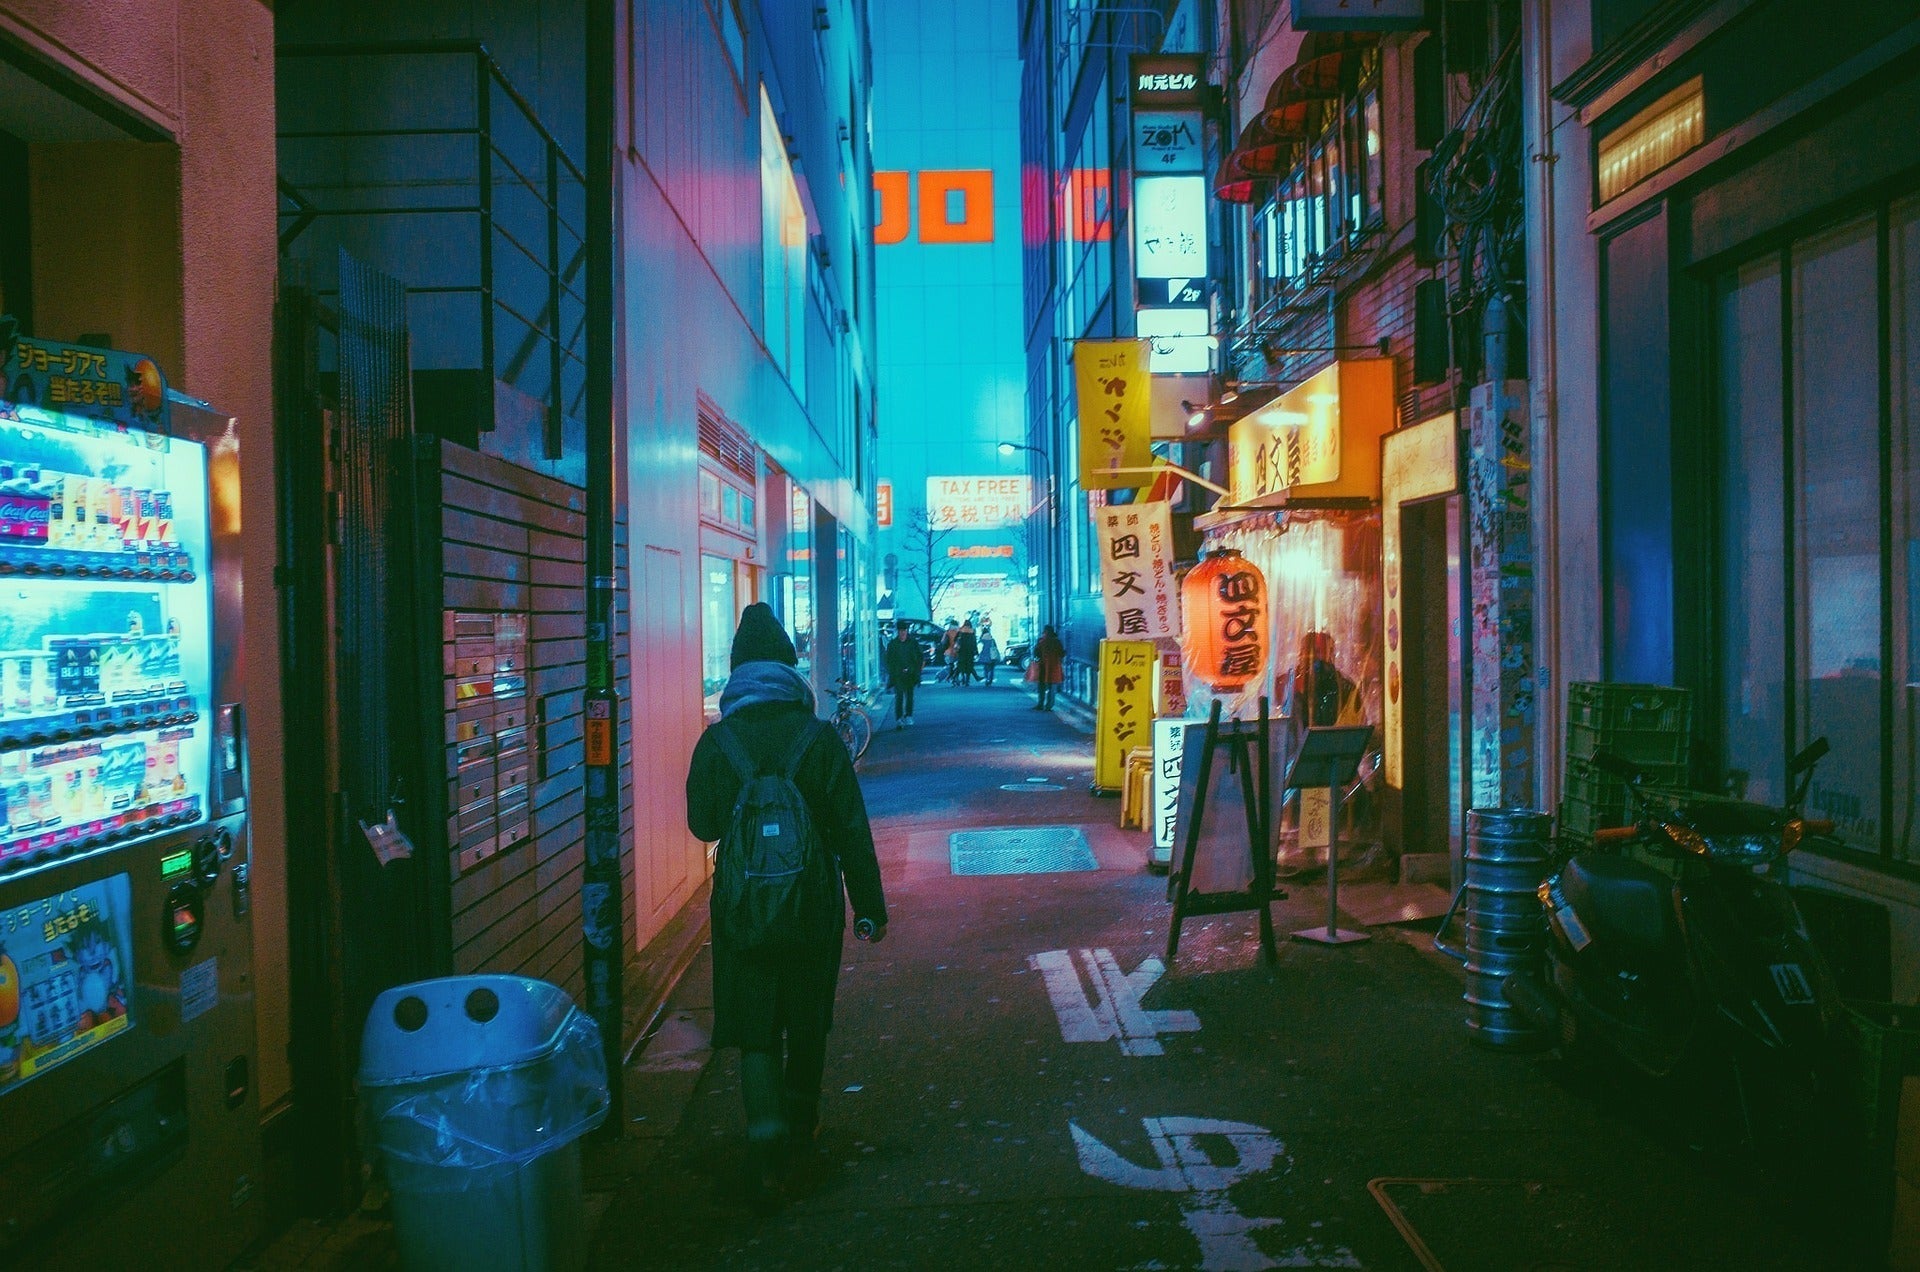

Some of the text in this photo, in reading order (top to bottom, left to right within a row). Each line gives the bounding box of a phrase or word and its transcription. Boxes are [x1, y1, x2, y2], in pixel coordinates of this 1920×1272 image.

[1138, 73, 1199, 91] 川元ビル
[1161, 153, 1177, 164] 4F
[1182, 287, 1202, 302] 2F
[17, 343, 106, 378] ジョージアで
[940, 479, 1020, 495] TAX FREE
[1110, 533, 1150, 635] 四文屋
[1112, 646, 1146, 665] カレー
[1113, 673, 1142, 769] ガンジー
